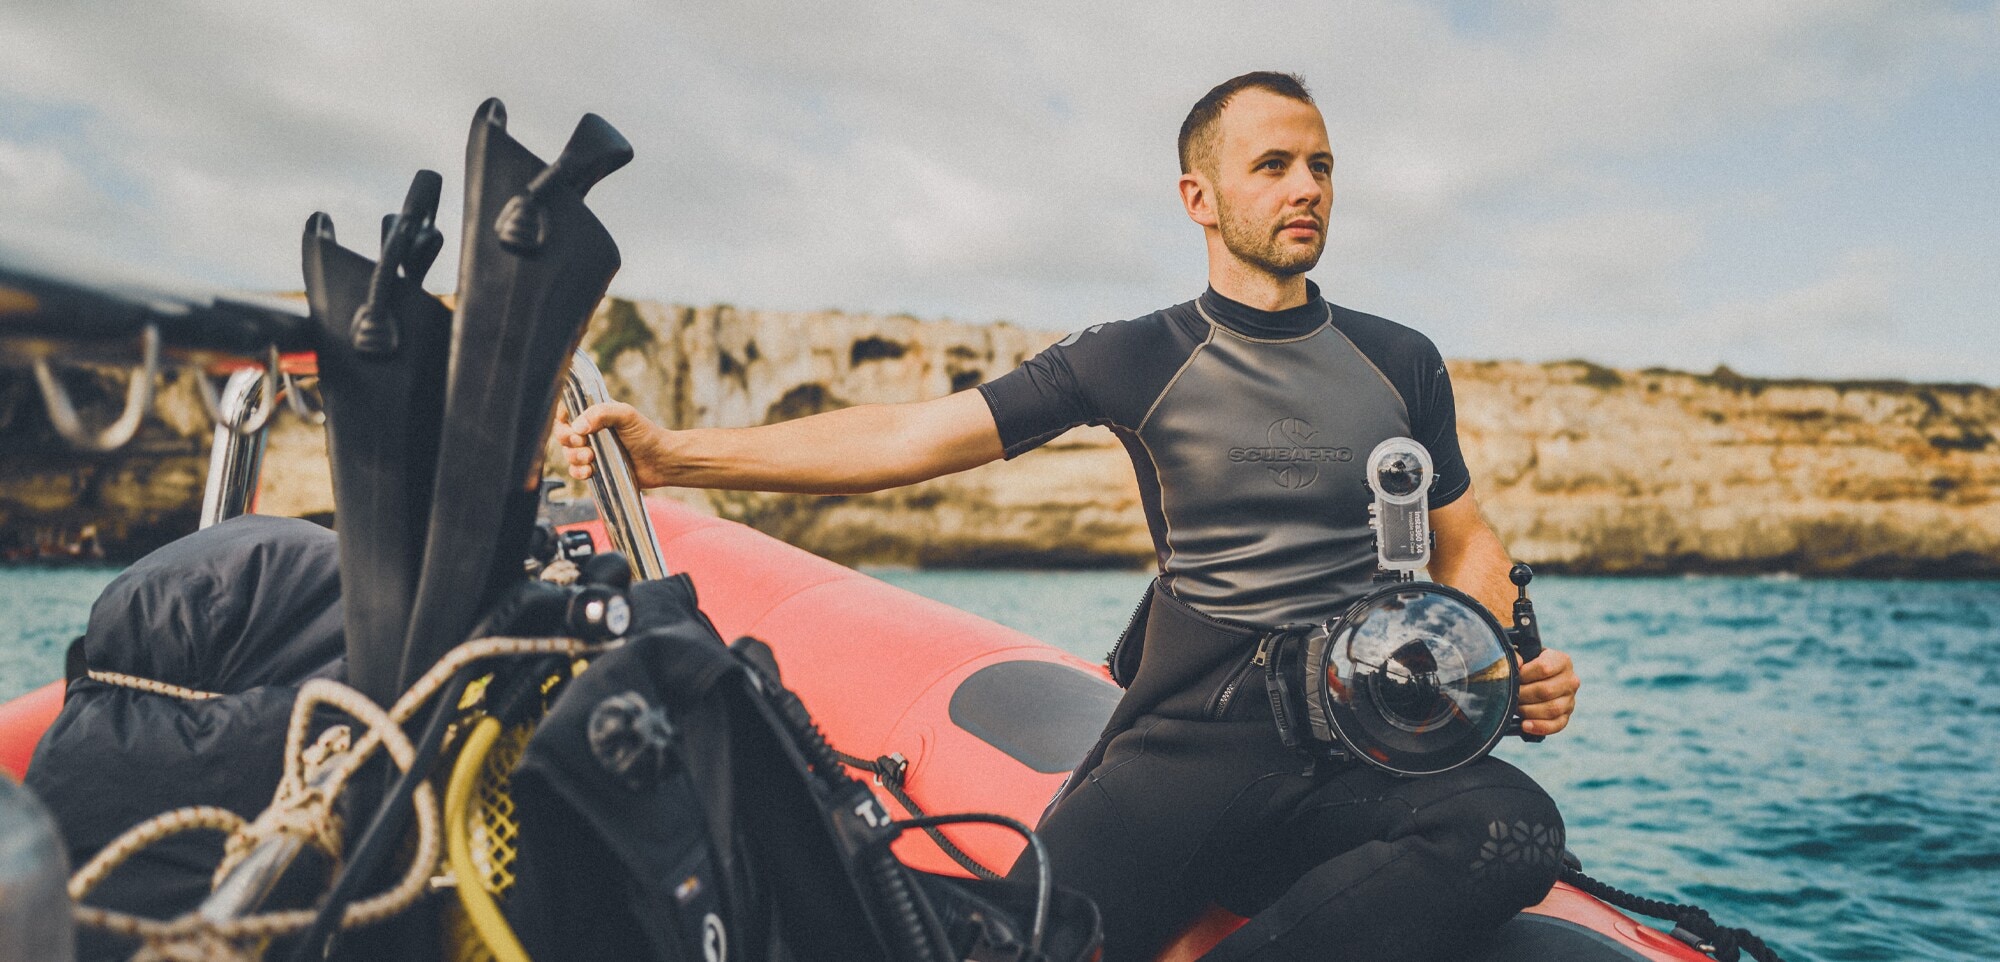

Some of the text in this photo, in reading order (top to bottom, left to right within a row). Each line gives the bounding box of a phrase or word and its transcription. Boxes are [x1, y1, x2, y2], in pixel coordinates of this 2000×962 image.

[1229, 447, 1352, 463] SCUBAPRO
[1415, 511, 1423, 554] Insta360 X4
